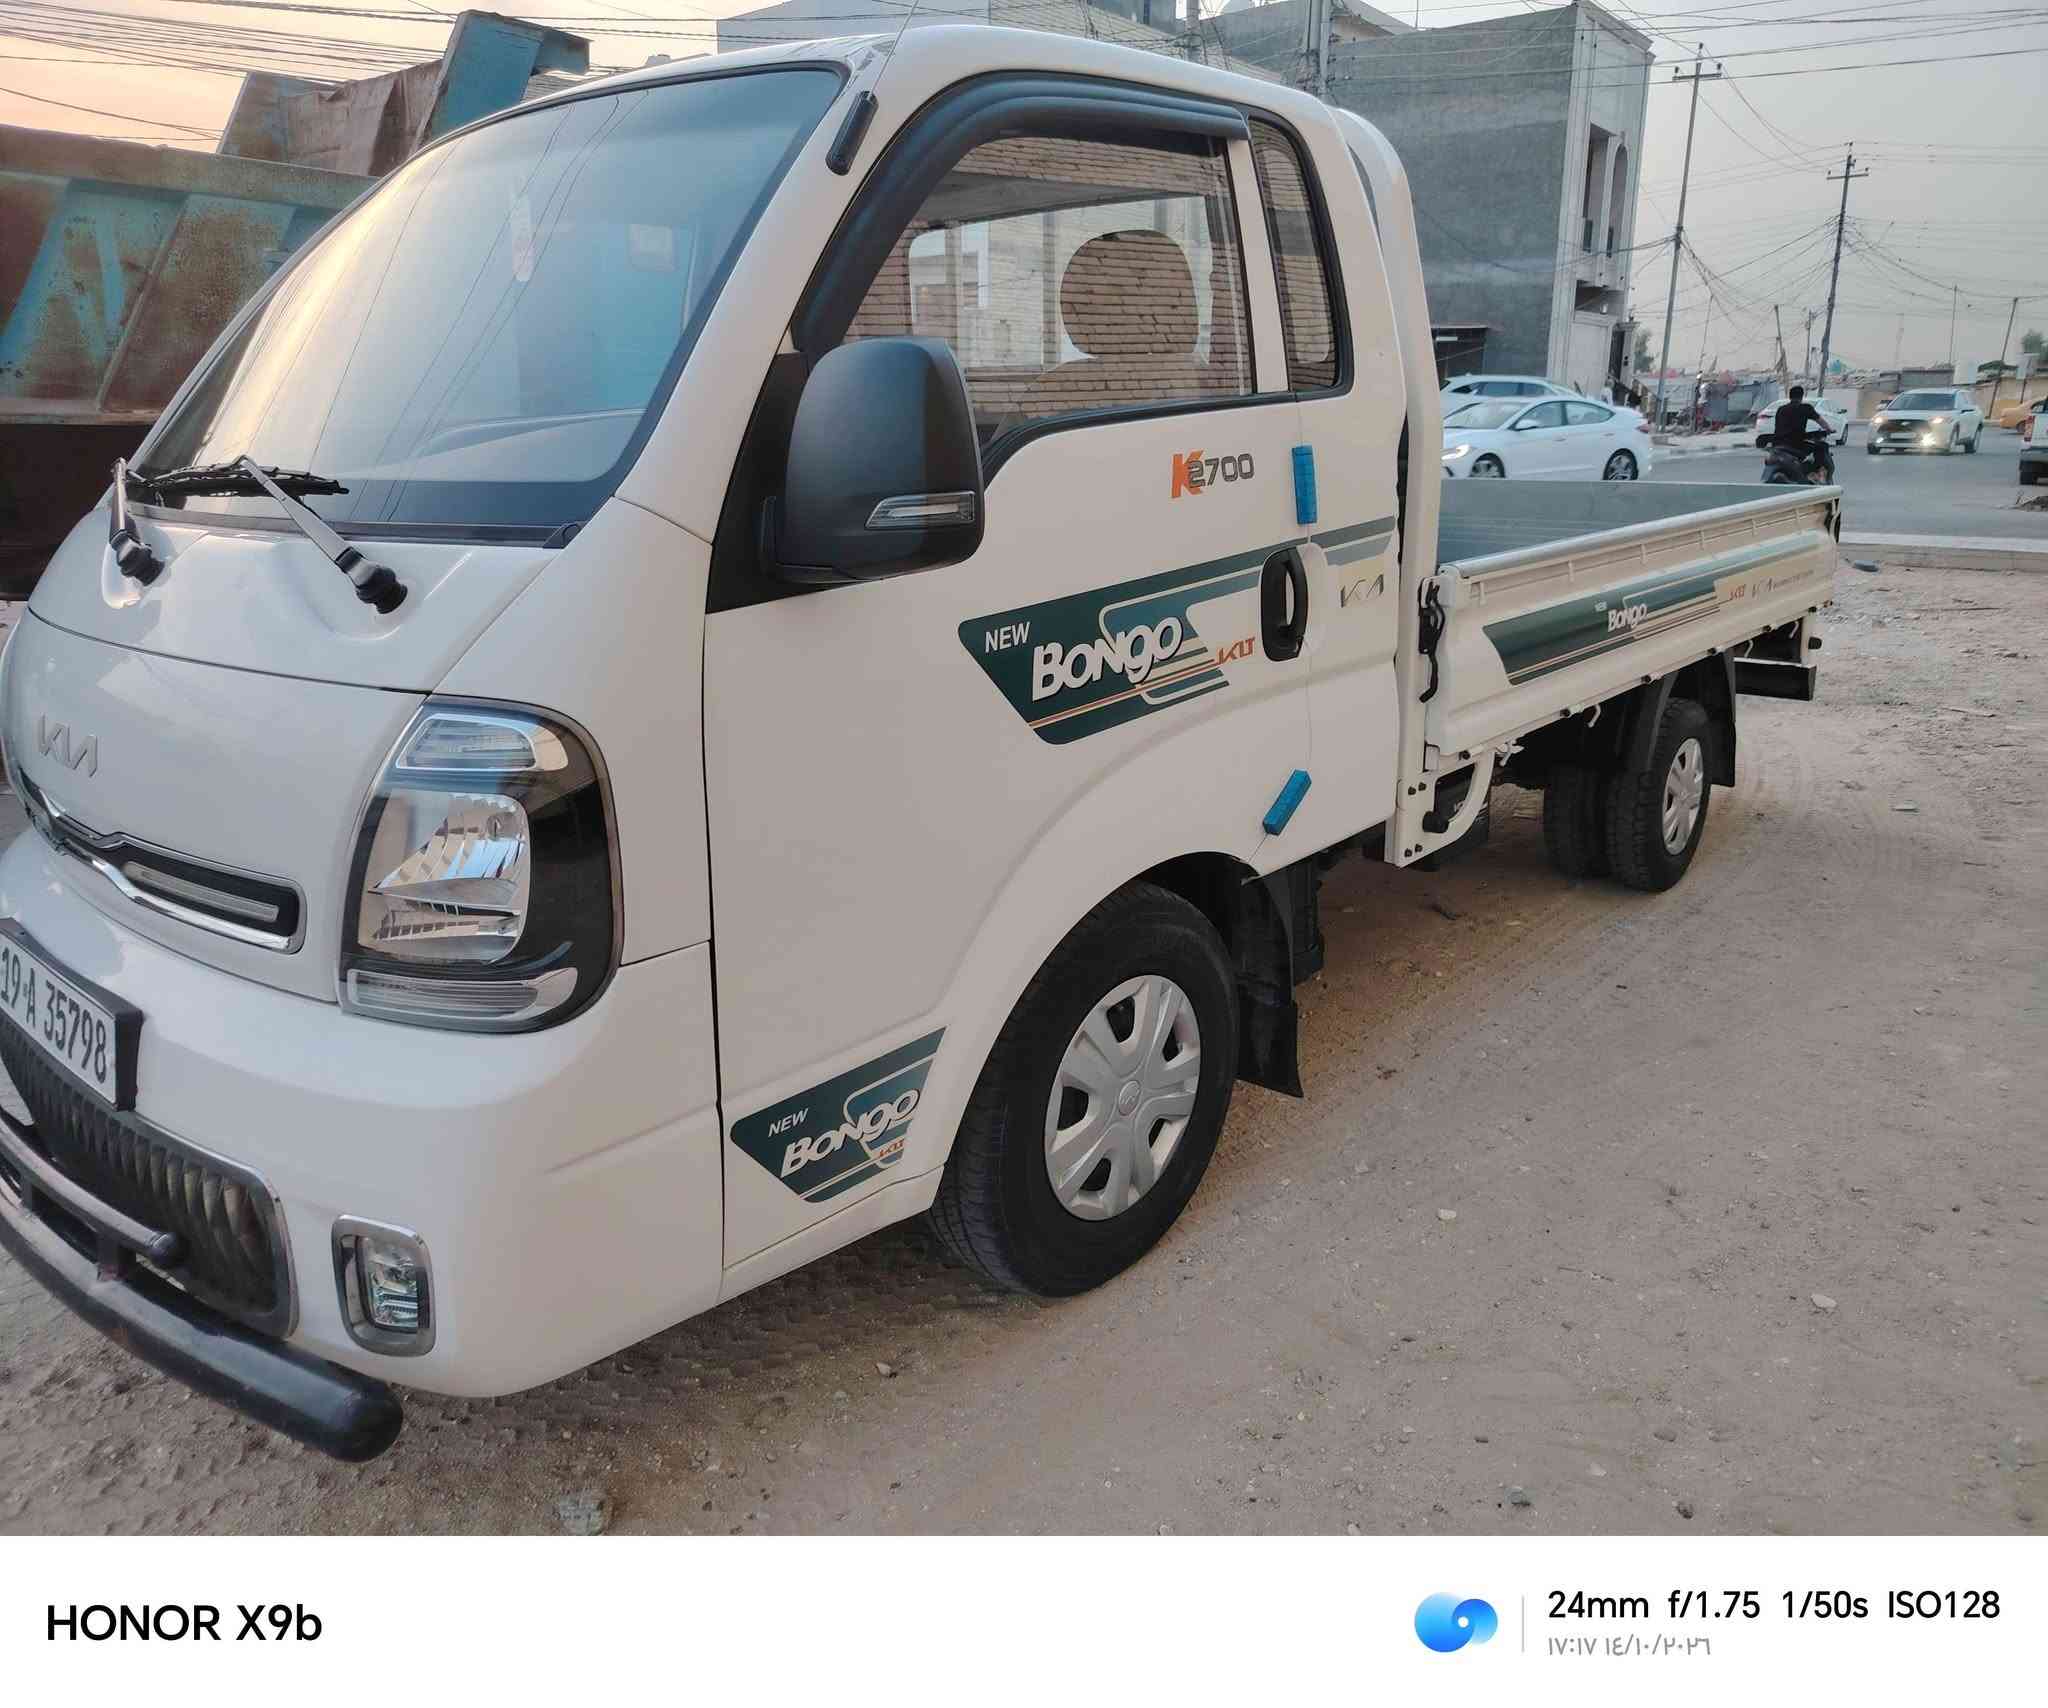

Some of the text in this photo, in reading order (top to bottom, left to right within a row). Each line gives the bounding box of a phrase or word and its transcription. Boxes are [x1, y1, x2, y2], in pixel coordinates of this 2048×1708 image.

[1171, 449, 1255, 498] K2700
[985, 621, 1030, 653] NEW
[36, 712, 99, 779] KIA
[1, 946, 21, 1009] 19
[44, 979, 107, 1084] 35798
[768, 1108, 809, 1137] NEW
